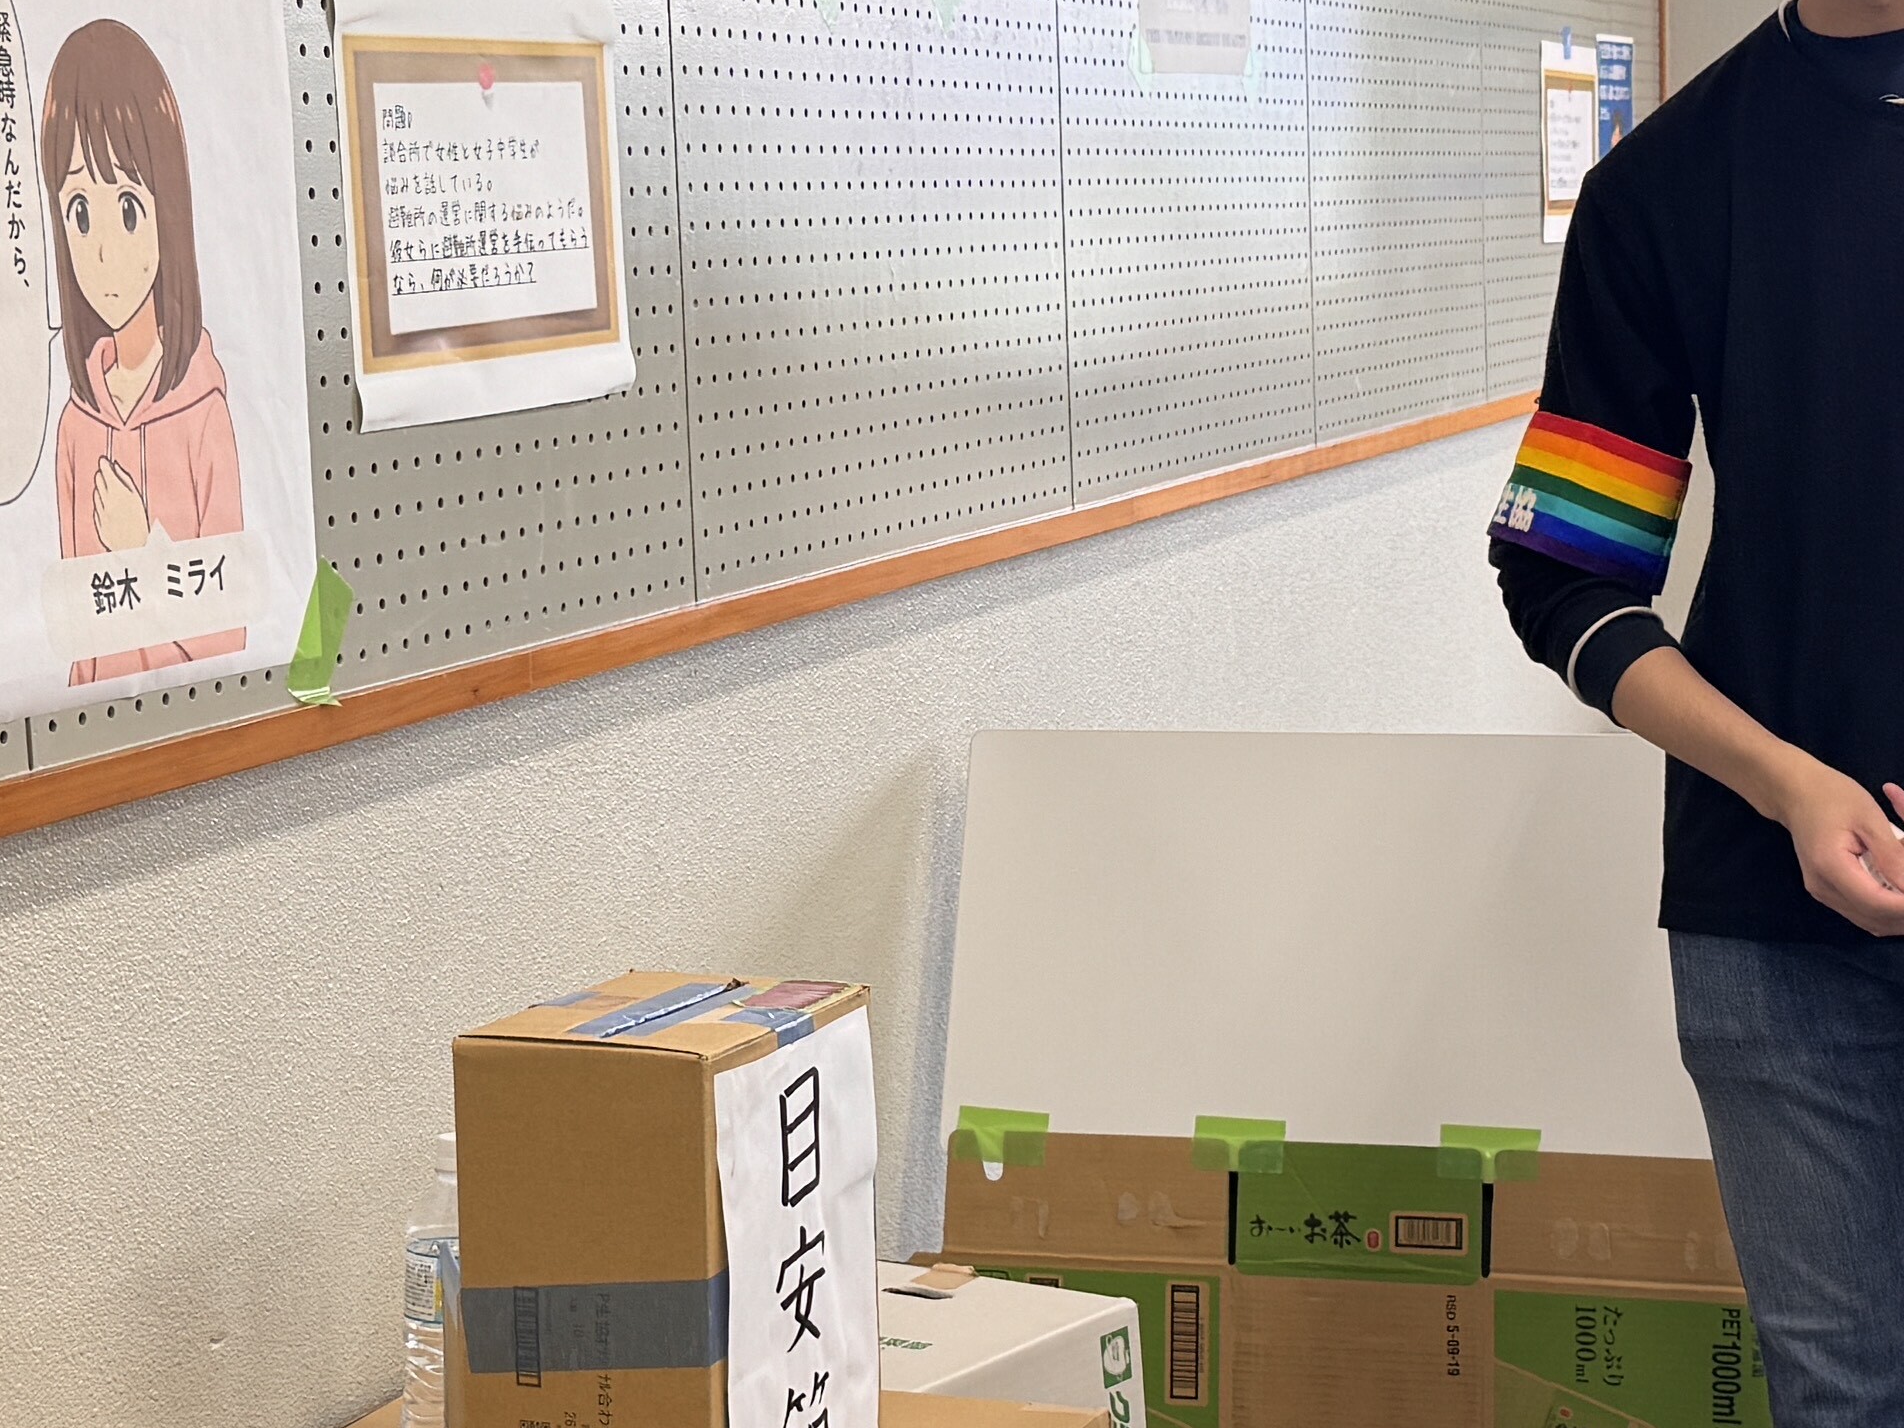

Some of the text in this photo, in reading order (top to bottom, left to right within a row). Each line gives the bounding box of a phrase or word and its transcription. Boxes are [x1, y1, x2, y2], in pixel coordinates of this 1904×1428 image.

[90, 555, 228, 614] 鈴木 ミライ
[1575, 1304, 1597, 1383] 1000ml
[1603, 1305, 1625, 1387] たっぷり
